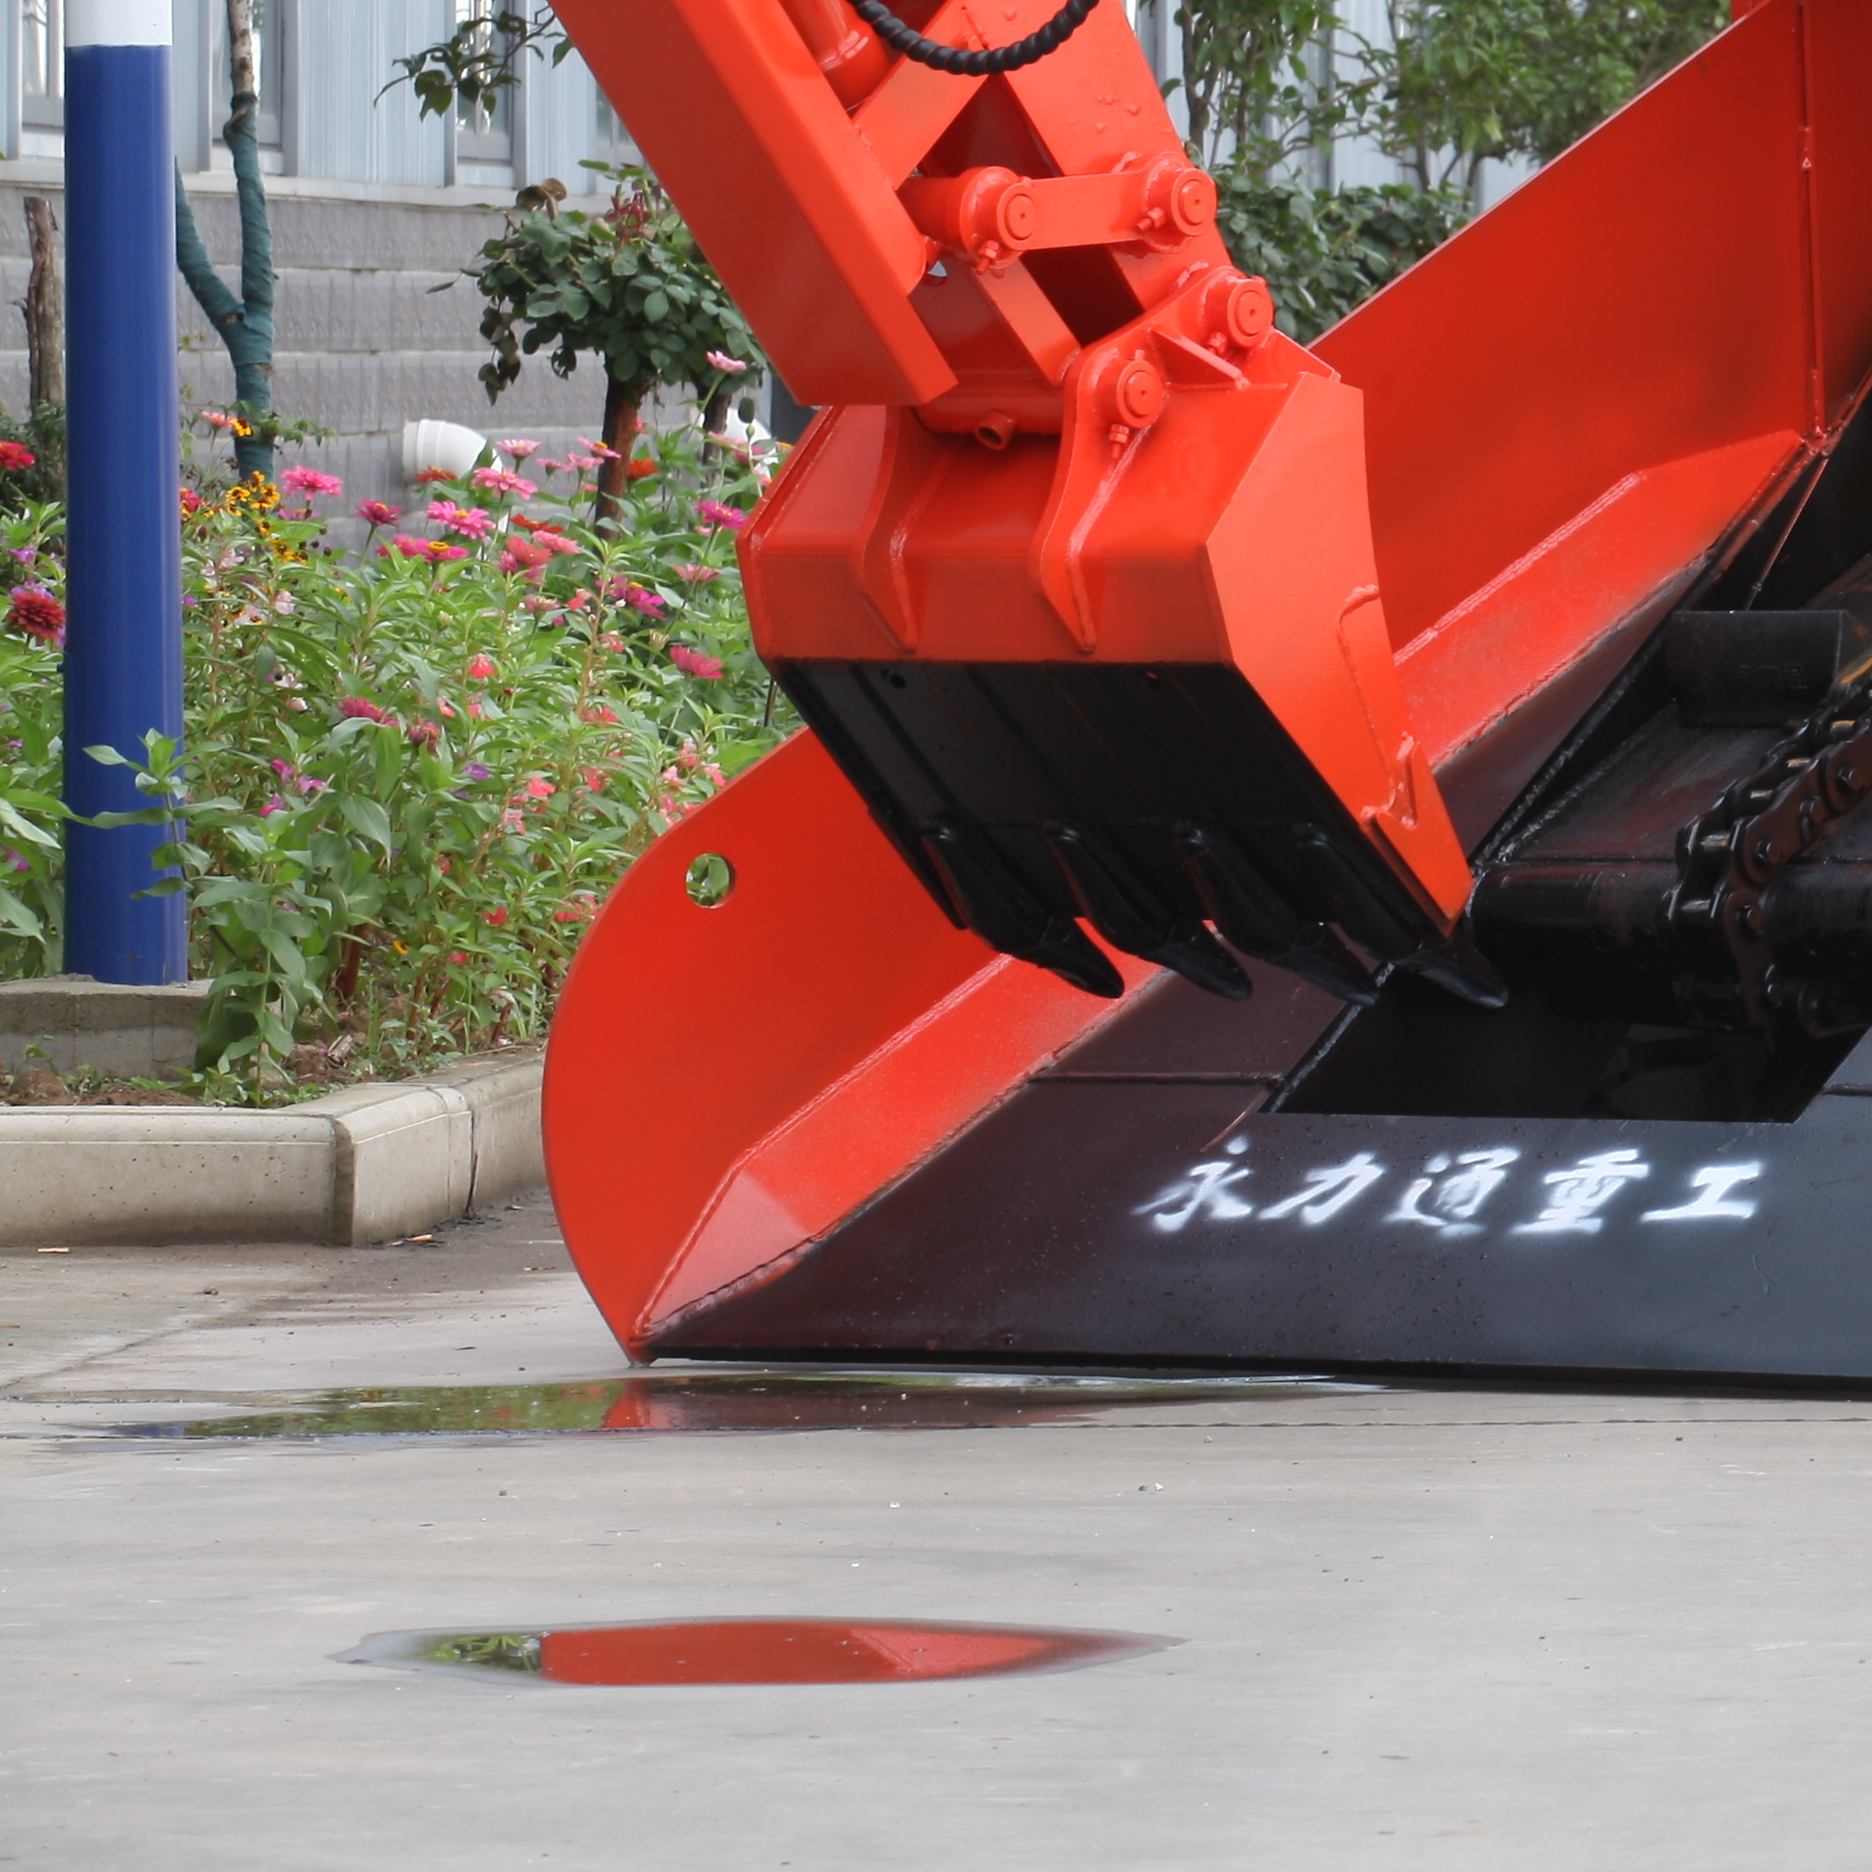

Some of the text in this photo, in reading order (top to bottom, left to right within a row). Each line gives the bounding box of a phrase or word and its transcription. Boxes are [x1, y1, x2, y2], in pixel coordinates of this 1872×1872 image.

[1131, 1134, 1764, 1237] 永力通重工
